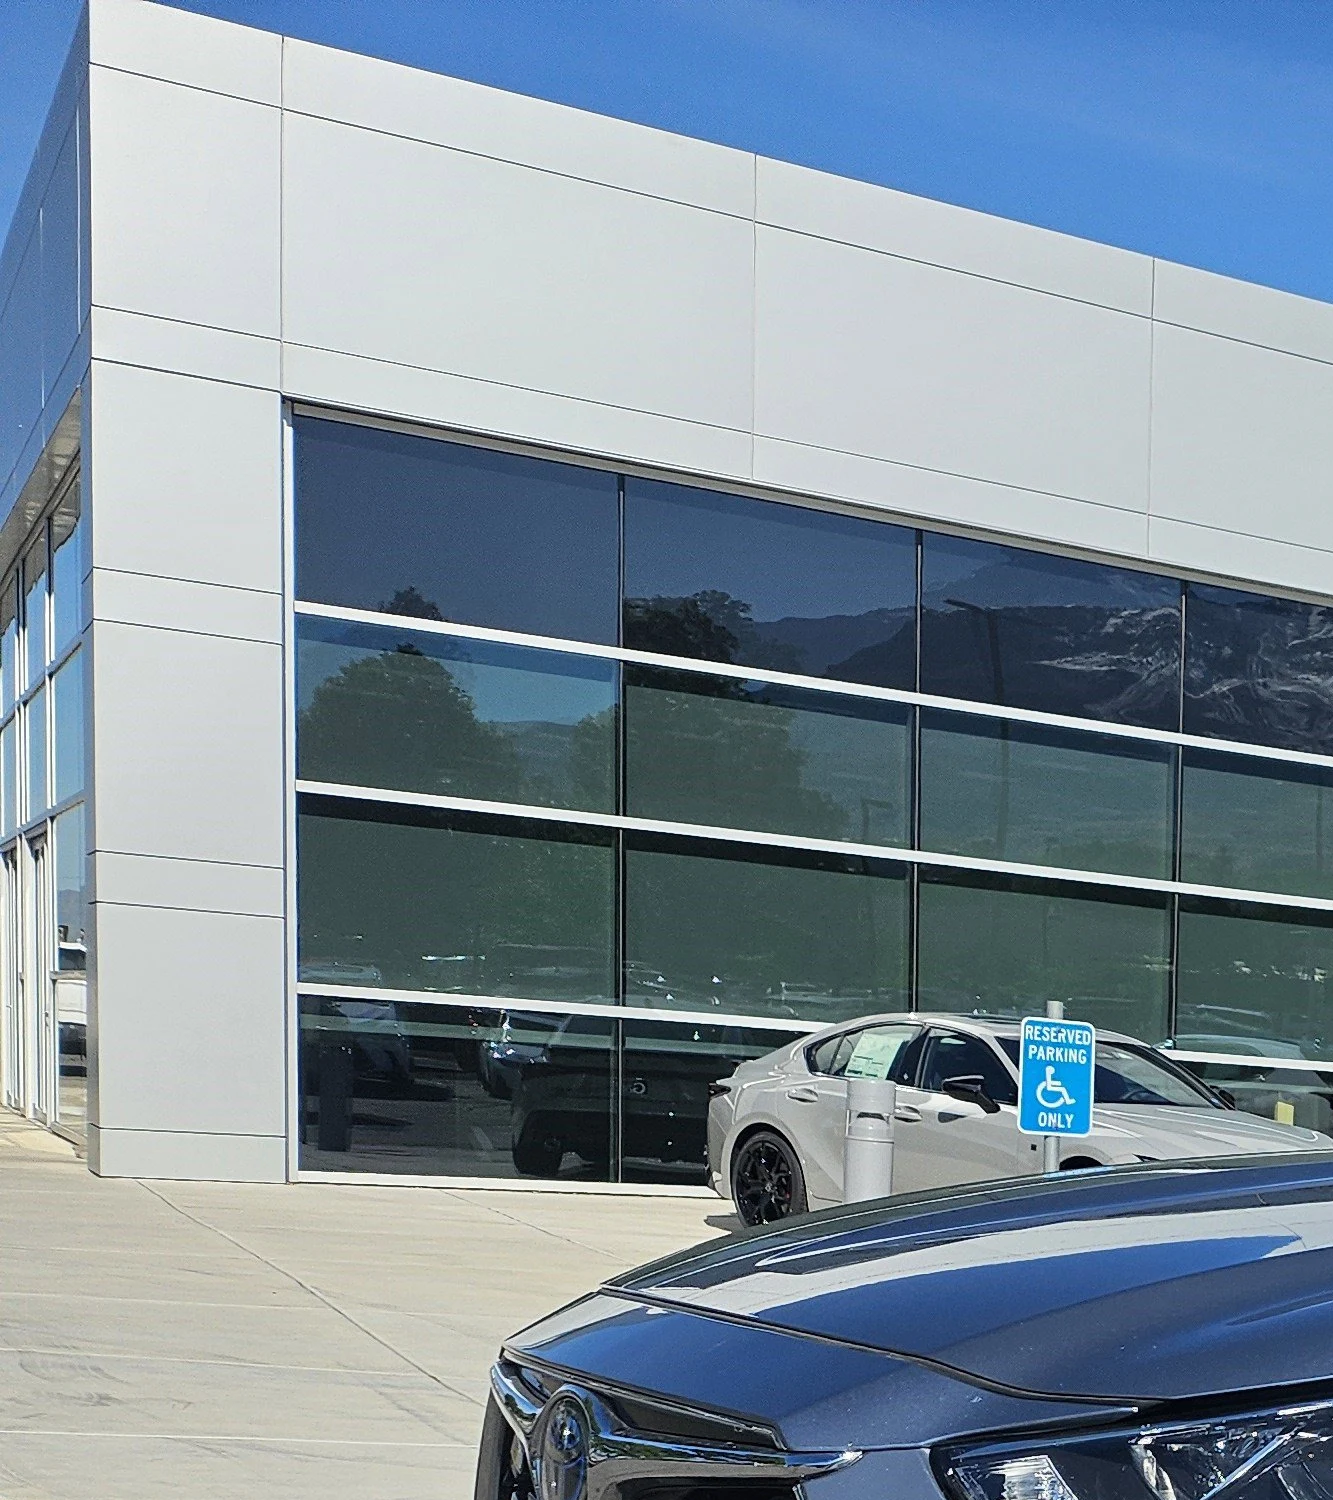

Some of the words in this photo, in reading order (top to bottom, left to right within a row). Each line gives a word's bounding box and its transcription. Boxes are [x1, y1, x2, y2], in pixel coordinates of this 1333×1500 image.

[1025, 1024, 1092, 1046] RESERVED
[1028, 1045, 1087, 1064] PARKING
[1038, 1112, 1075, 1129] ONLY
